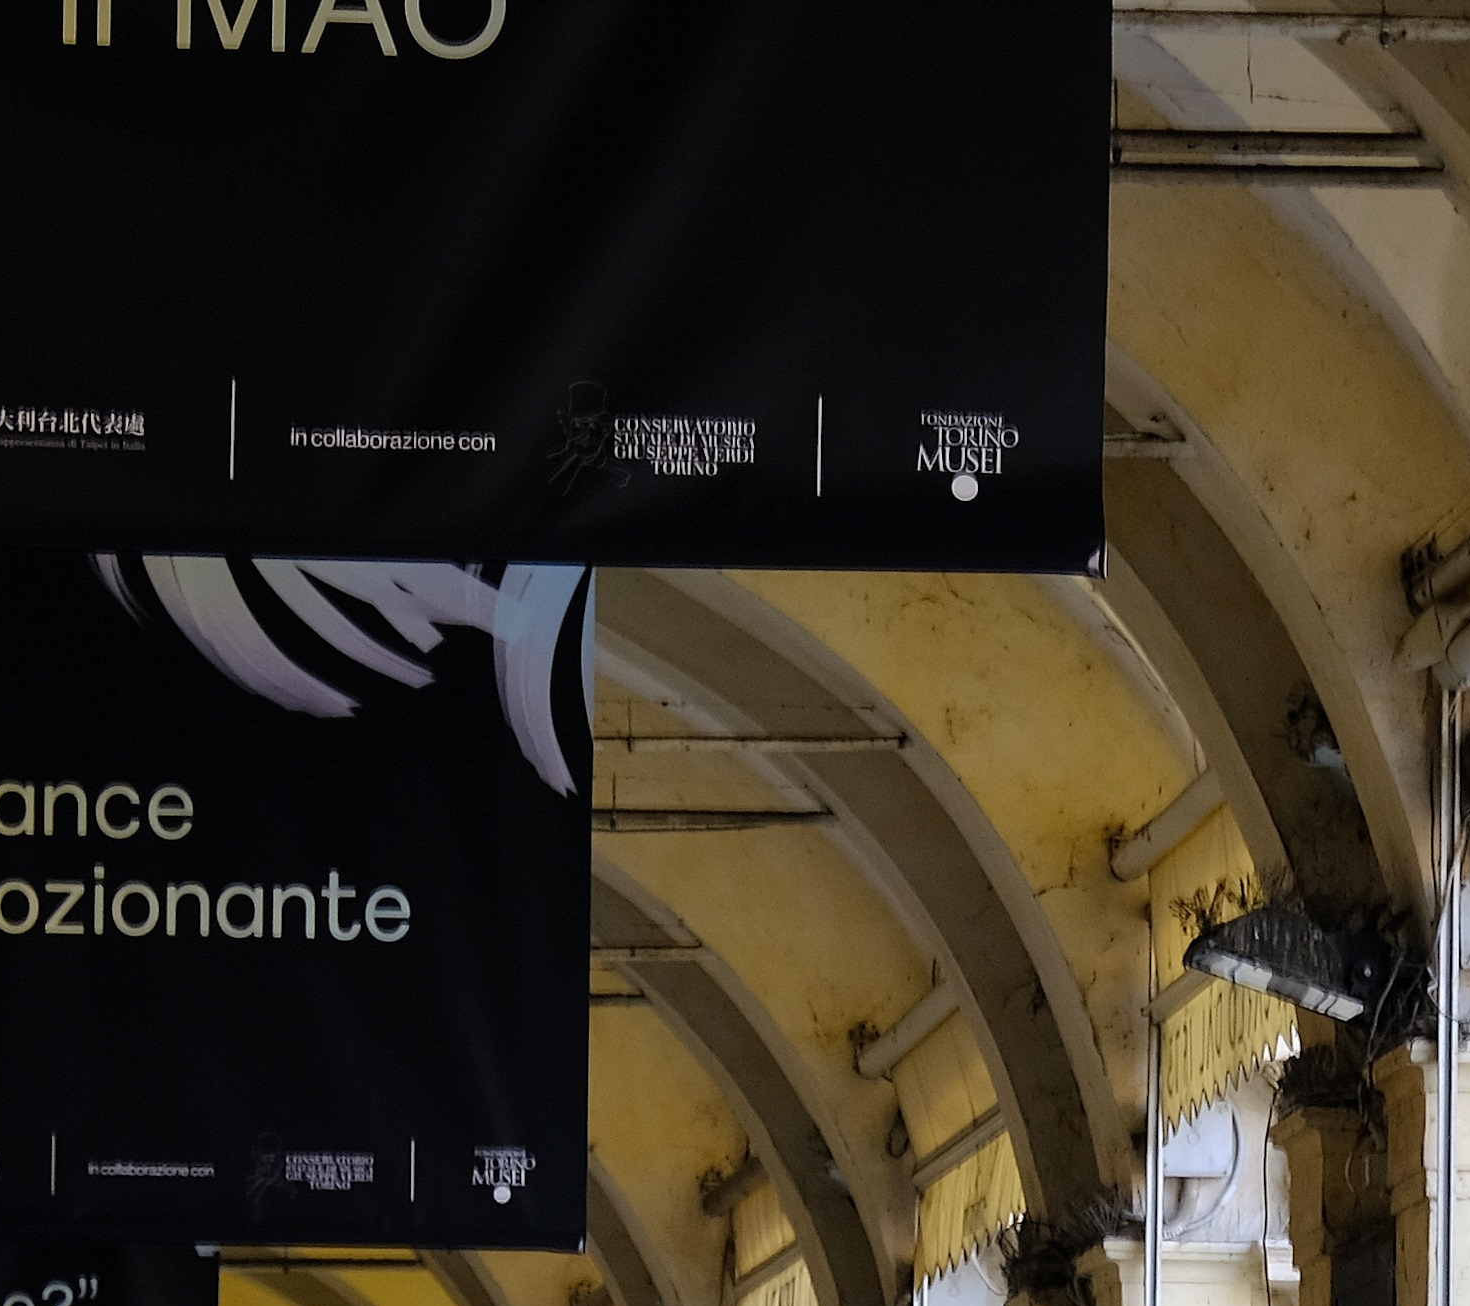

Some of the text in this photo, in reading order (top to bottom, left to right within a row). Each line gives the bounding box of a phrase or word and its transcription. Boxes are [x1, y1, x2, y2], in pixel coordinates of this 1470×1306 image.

[614, 417, 756, 436] CONSERVATORIO
[933, 425, 1020, 449] TORINO
[290, 426, 497, 452] in collaborazione con
[614, 445, 755, 463] GIUSEPPE VERDI
[917, 443, 1003, 474] MUSEI
[650, 460, 718, 476] TORINO
[472, 1166, 526, 1187] MUSEI
